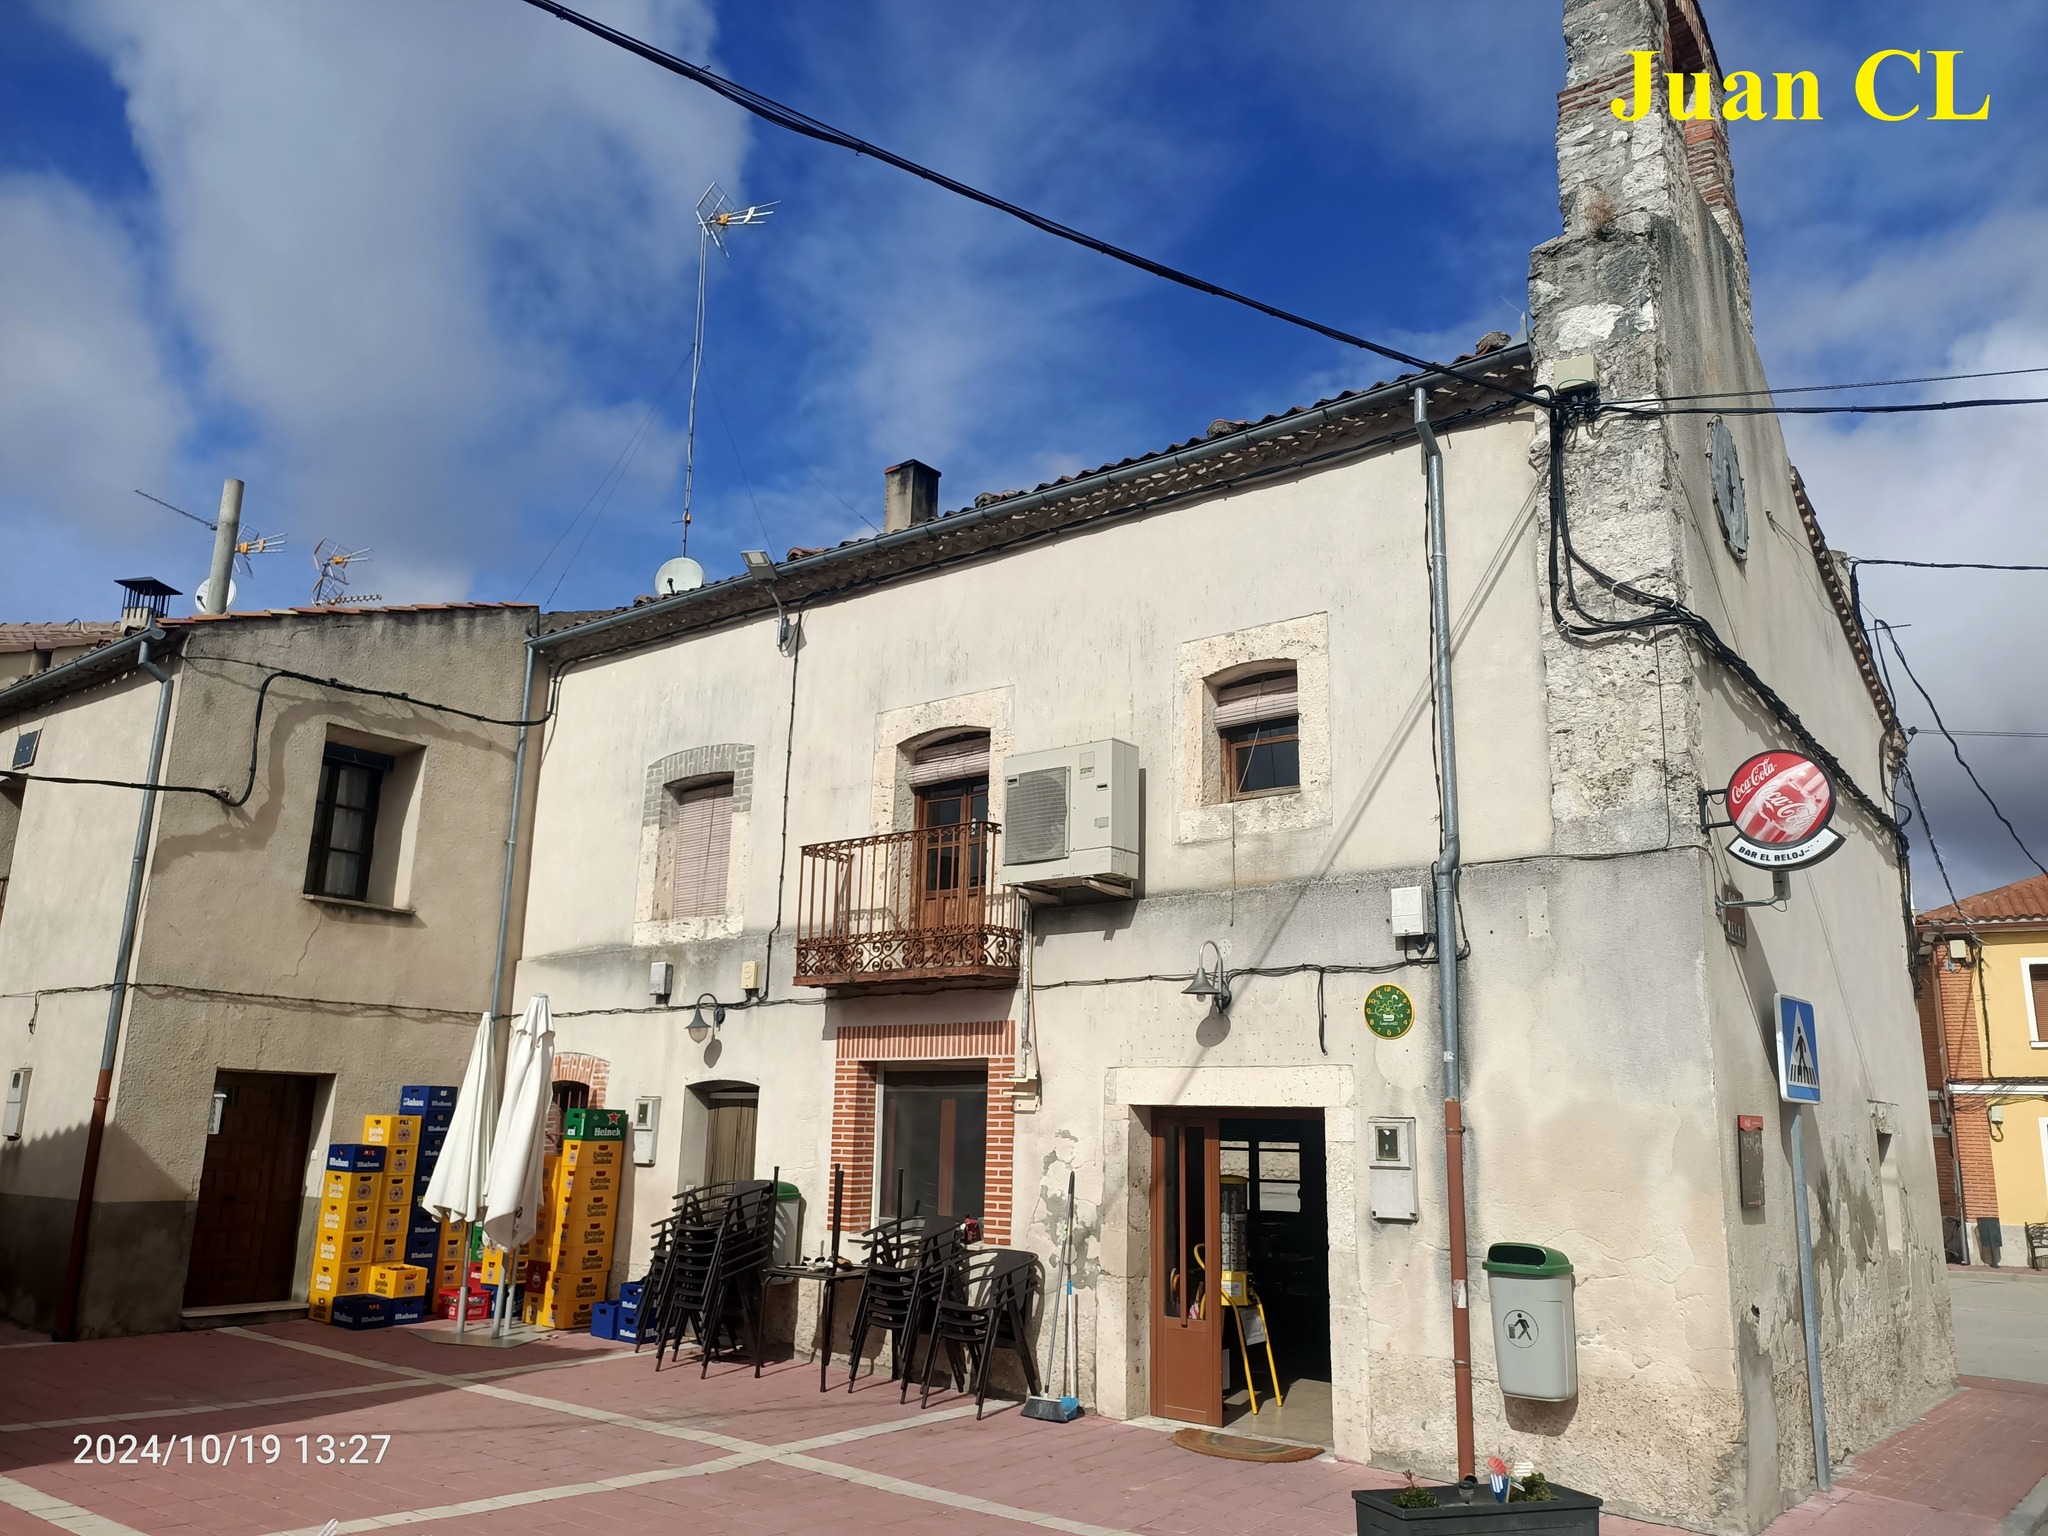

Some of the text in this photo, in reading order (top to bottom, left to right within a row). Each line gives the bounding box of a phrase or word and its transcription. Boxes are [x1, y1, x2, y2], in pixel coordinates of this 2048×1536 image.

[1731, 757, 1778, 804] Coca-Cola
[1738, 846, 1758, 859] BAR
[1760, 853, 1771, 862] EL
